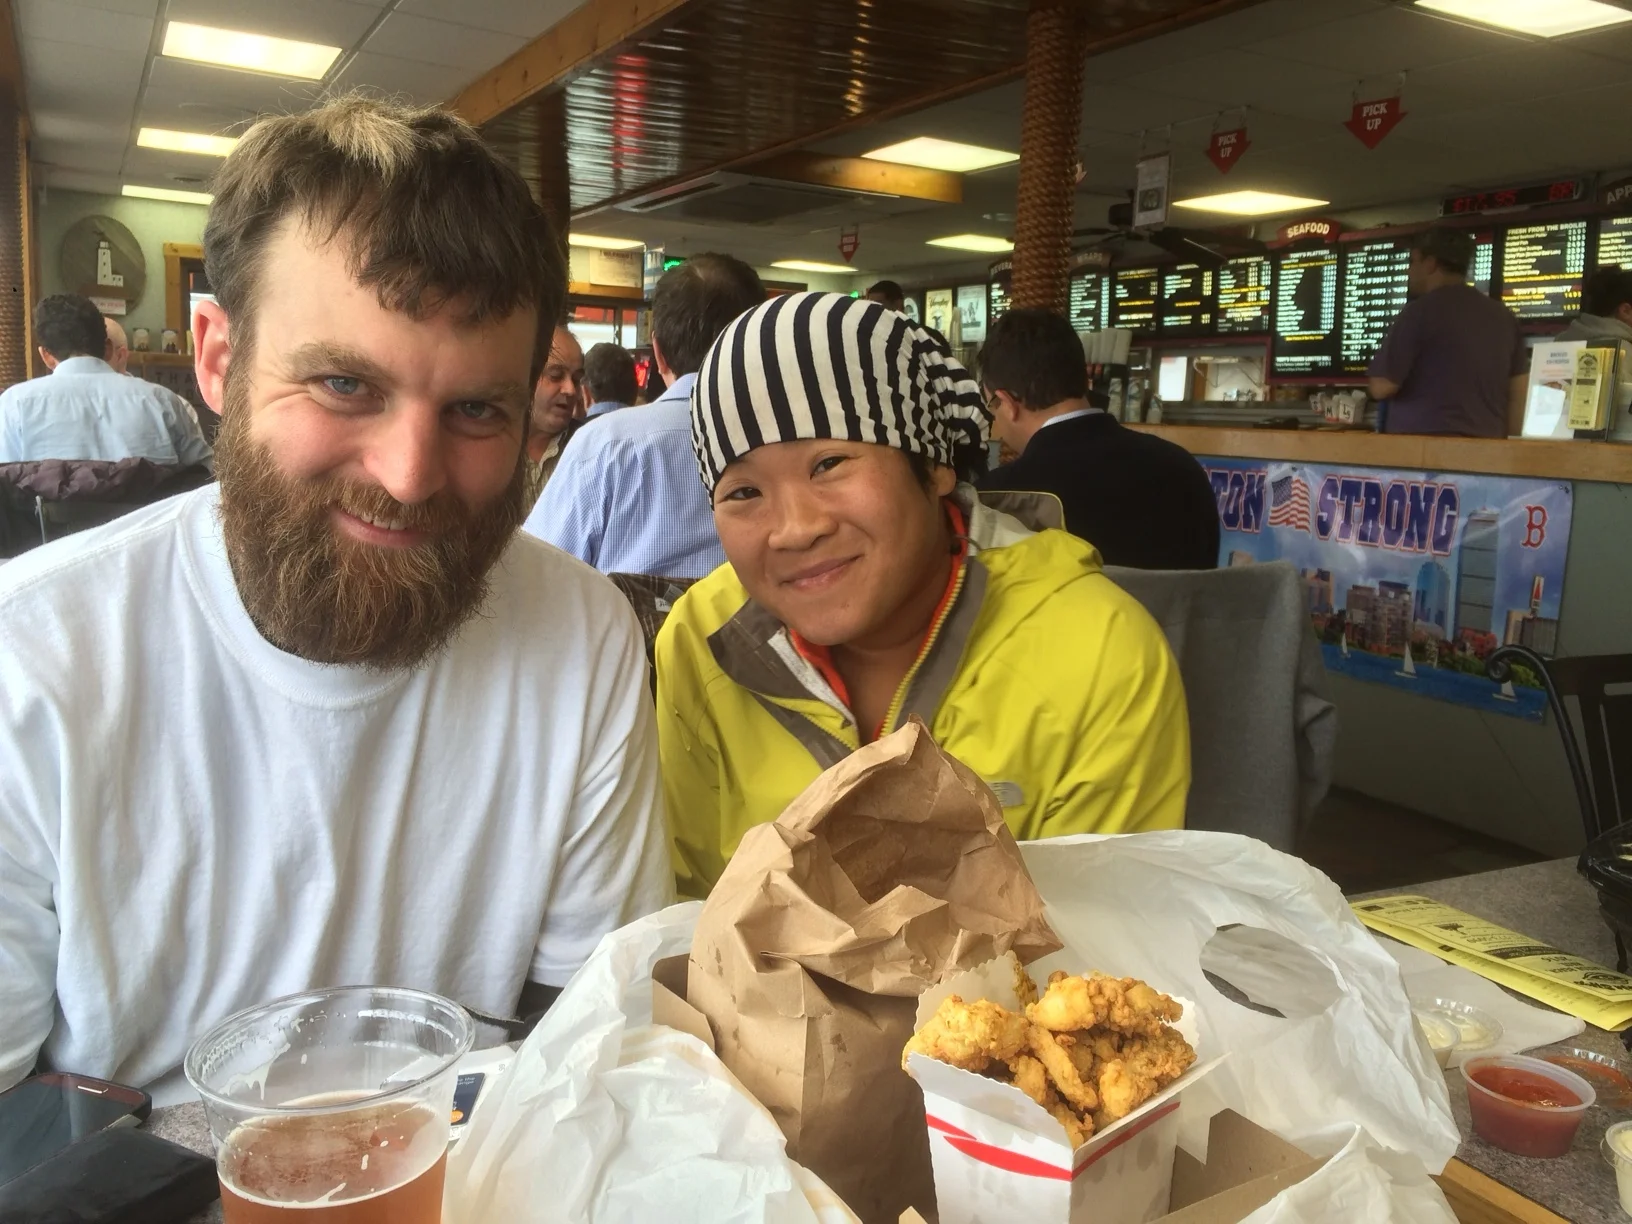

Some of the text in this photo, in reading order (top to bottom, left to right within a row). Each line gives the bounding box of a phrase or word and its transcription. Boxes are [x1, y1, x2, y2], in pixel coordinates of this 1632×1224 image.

[1362, 102, 1388, 118] PICK
[1366, 118, 1382, 131] UP
[1218, 133, 1237, 147] PICK
[1220, 147, 1232, 158] UP
[1286, 222, 1330, 238] SEAFOOD
[1559, 221, 1587, 230] BROILER
[1076, 253, 1103, 264] WRAPS
[1314, 472, 1461, 557] STRONG
[1519, 503, 1549, 550] B
